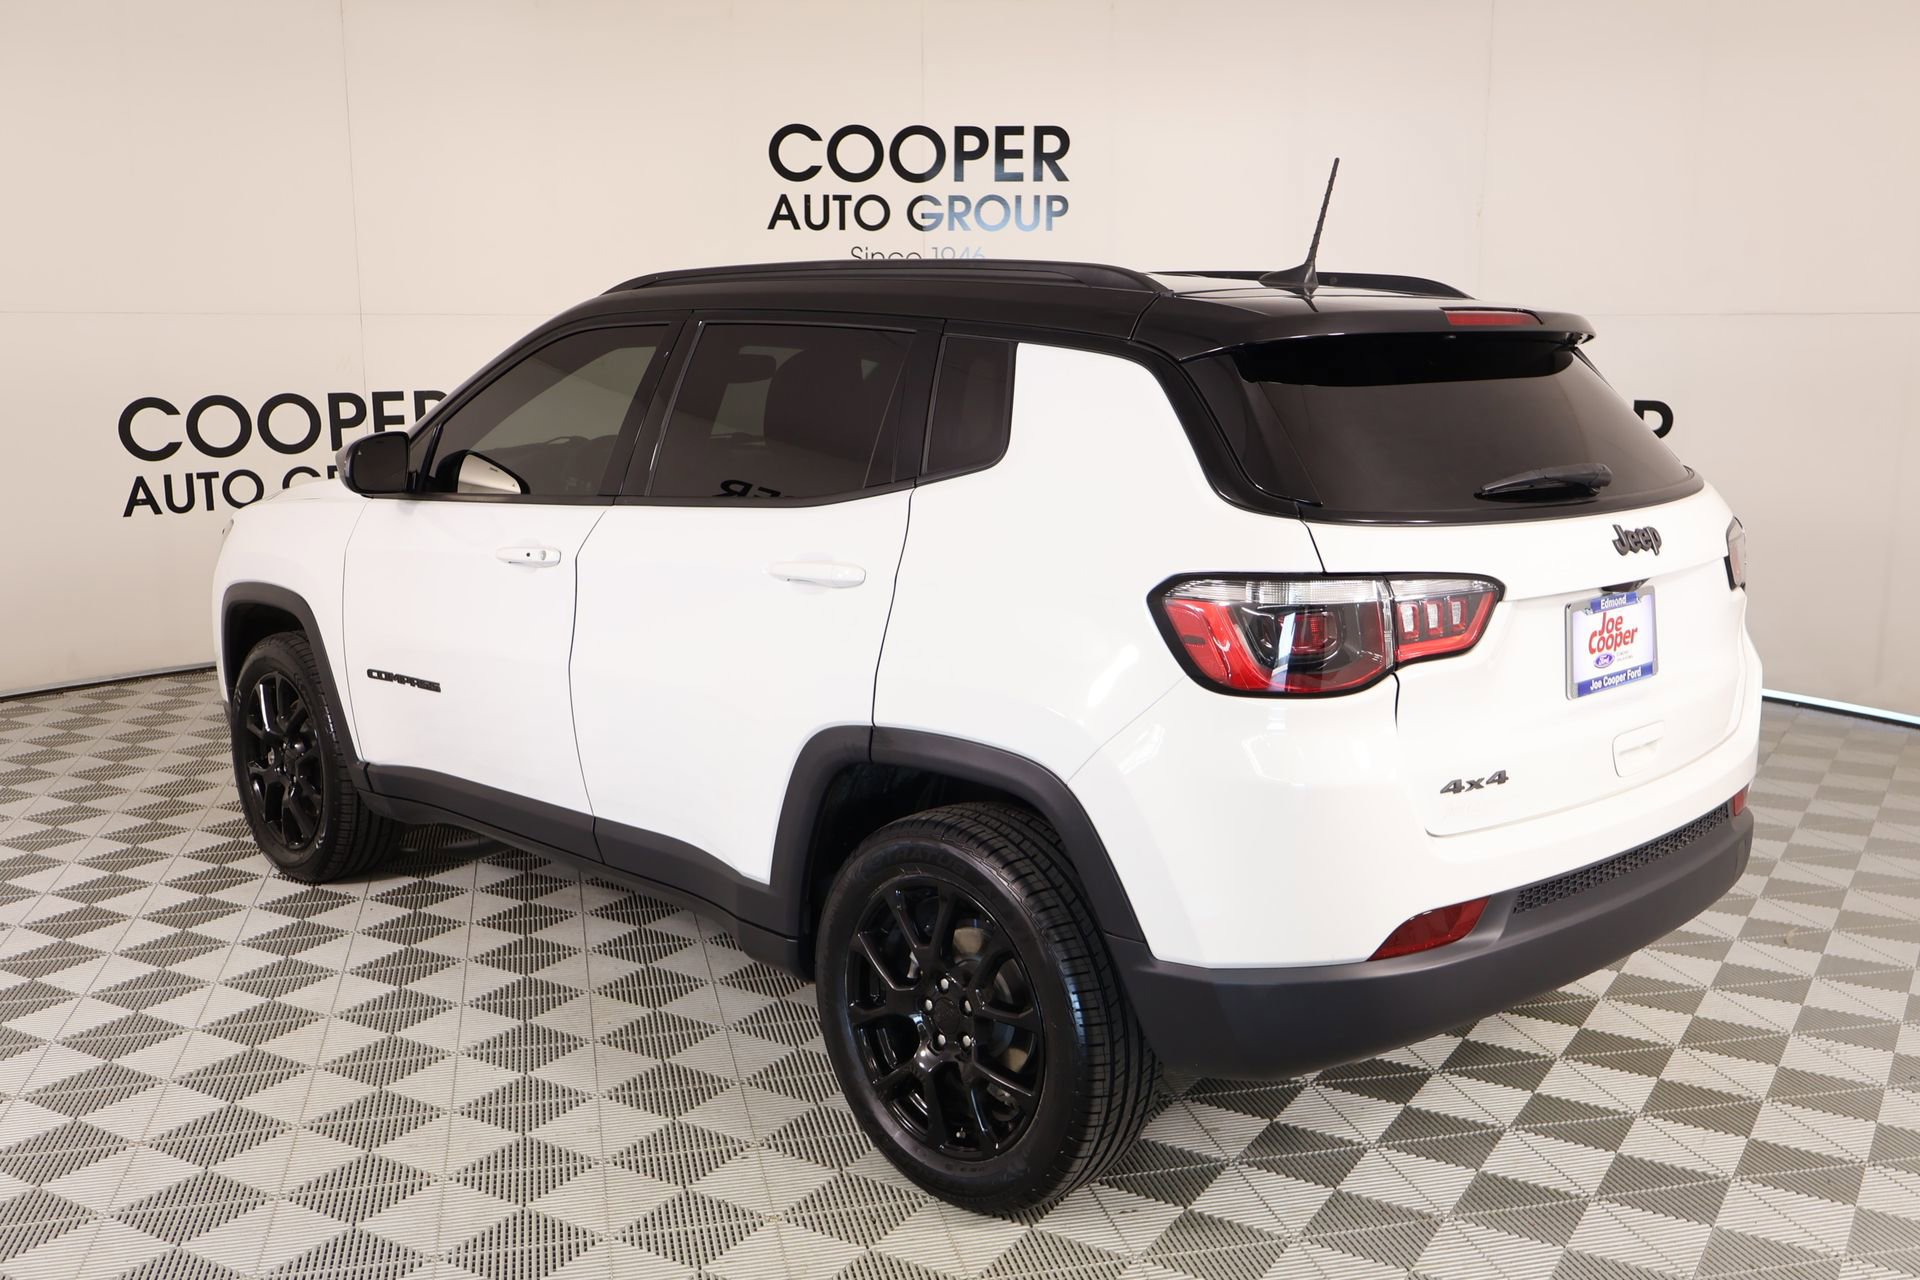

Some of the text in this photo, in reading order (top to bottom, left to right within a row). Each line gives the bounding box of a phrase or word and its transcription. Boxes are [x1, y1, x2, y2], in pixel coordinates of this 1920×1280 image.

[768, 123, 1071, 183] COOPER
[767, 194, 1069, 232] AUTO GROUP
[123, 469, 264, 518] AUTO
[1612, 524, 1663, 556] Jeep
[1600, 595, 1627, 610] Edmond
[1598, 612, 1623, 636] Joe
[1588, 627, 1638, 655] Cooper
[366, 668, 442, 693] COMPASS
[1590, 666, 1642, 690] Joe Cooper Ford
[1440, 769, 1509, 794] 4x4
